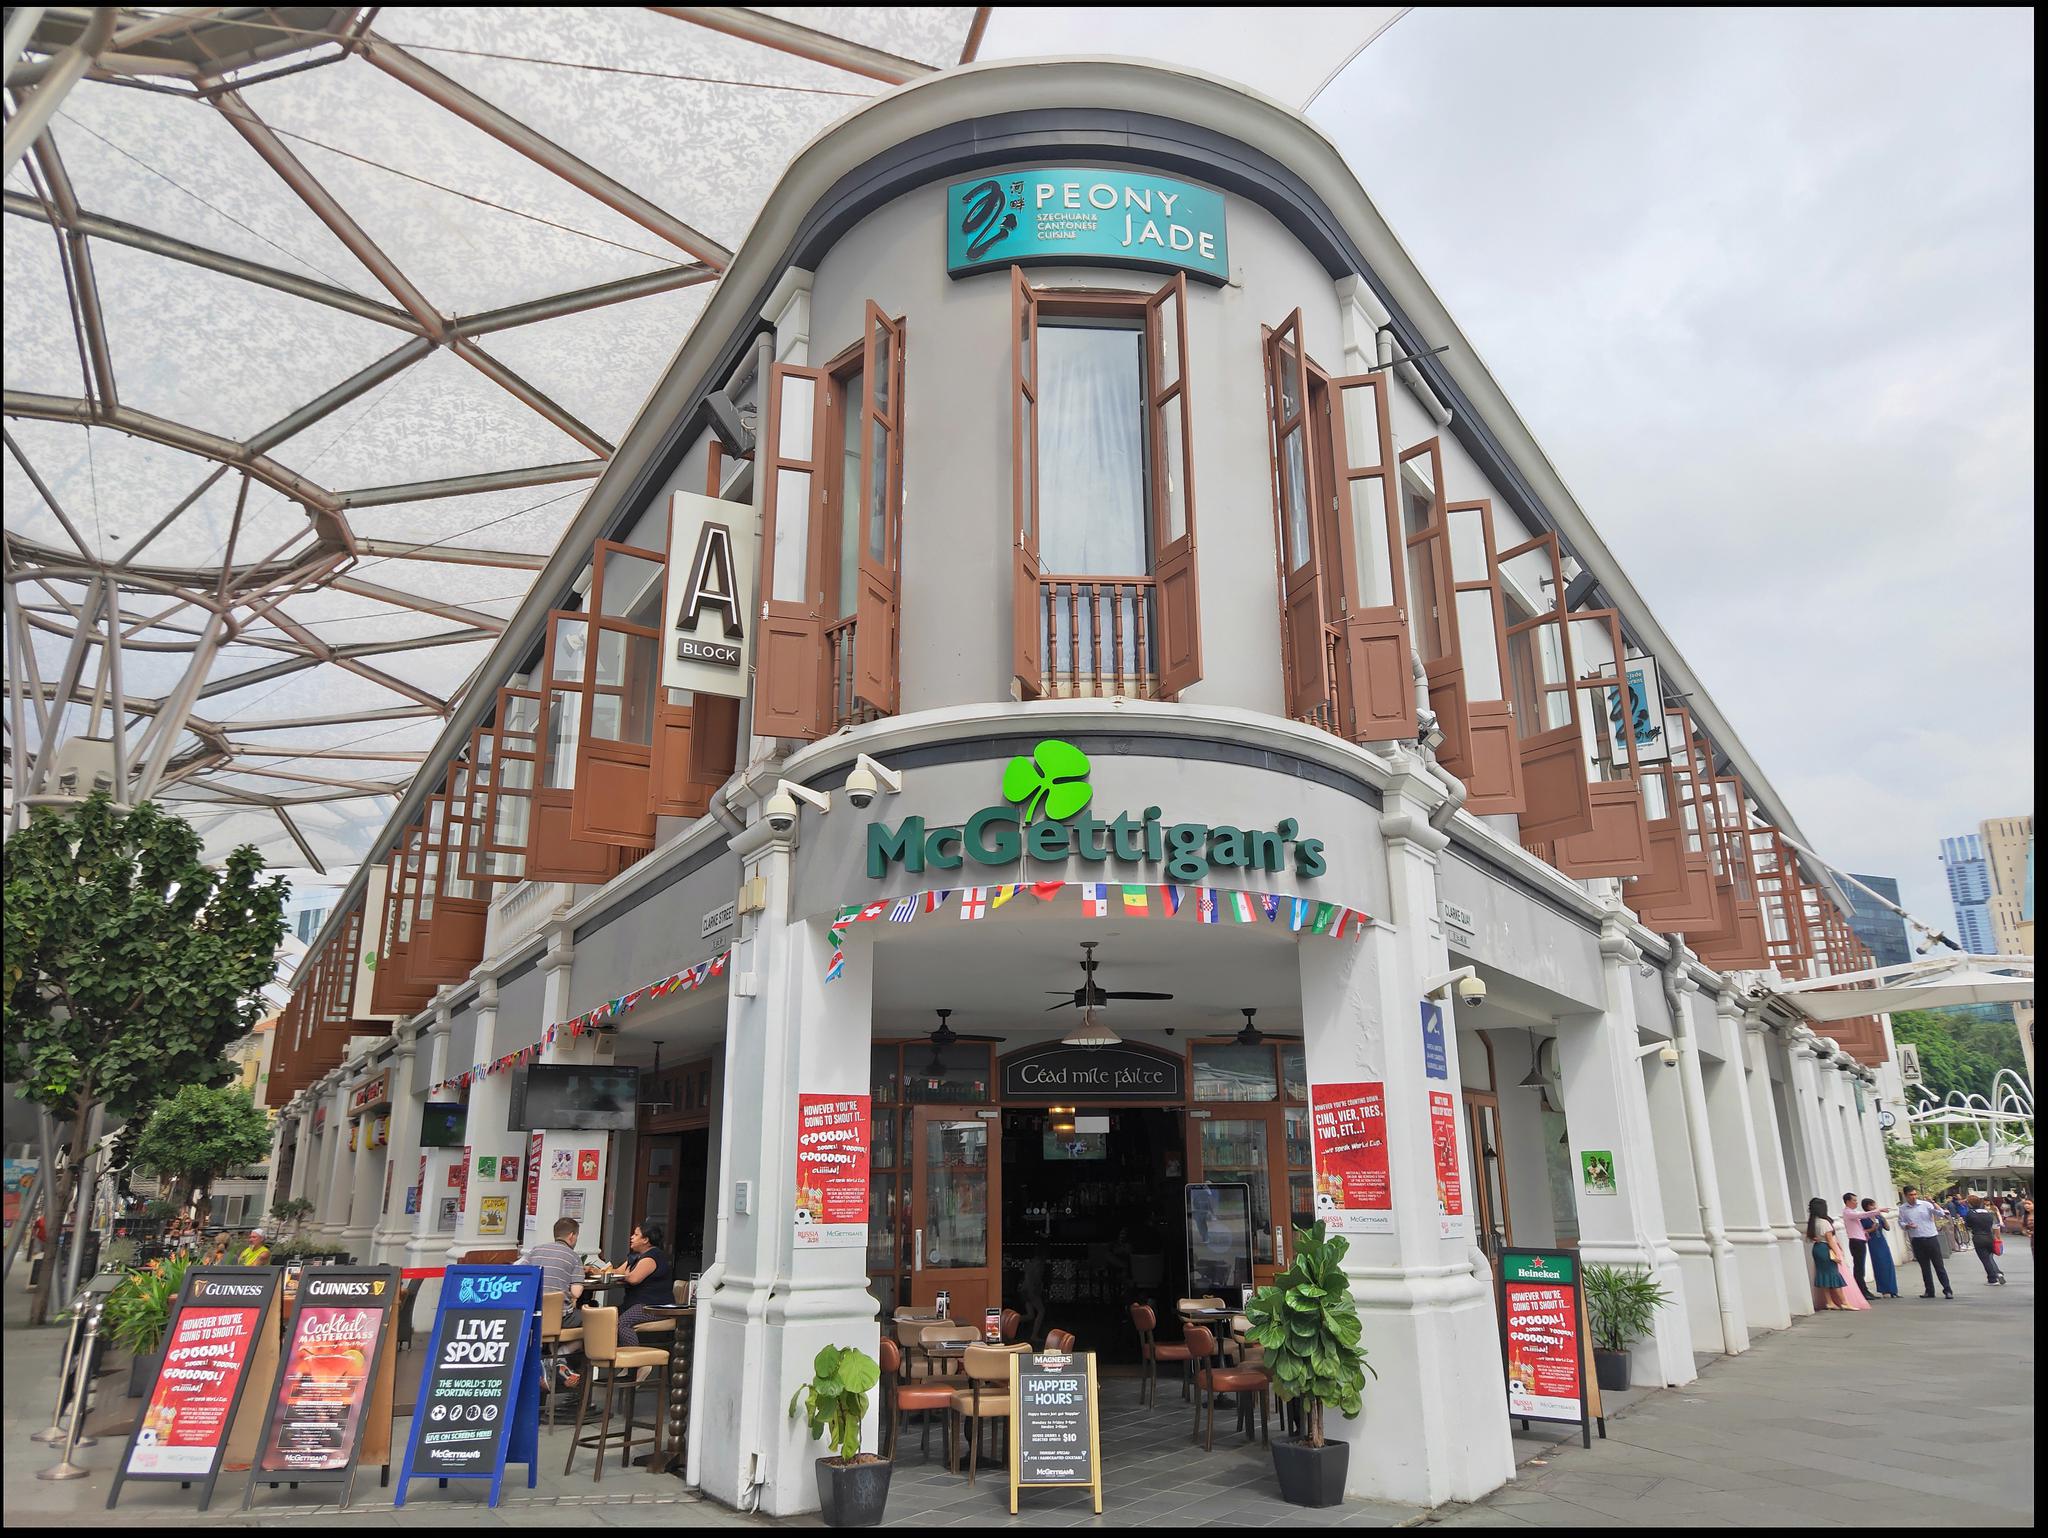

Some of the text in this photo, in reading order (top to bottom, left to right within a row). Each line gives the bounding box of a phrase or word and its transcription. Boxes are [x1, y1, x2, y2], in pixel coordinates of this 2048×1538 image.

[1036, 183, 1179, 218] PEONY
[1037, 213, 1090, 222] SZECHUAN
[1037, 221, 1098, 231] CANTONESE
[1037, 231, 1078, 240] CUISINE
[1121, 213, 1217, 260] JADE
[676, 520, 744, 639] A
[683, 642, 736, 662] BLOCK
[867, 805, 1328, 882] McGettigan's
[703, 905, 735, 932] CLARKE STREET
[1444, 904, 1472, 927] CLARKE QUAY
[1904, 1049, 1919, 1074] A
[1021, 1064, 1067, 1084] Céad
[804, 1100, 858, 1116] HOWEVER YOU'RE
[1333, 1100, 1347, 1109] YOU'RE
[804, 1111, 866, 1128] GOING TO SHOUT IT...
[1315, 1104, 1384, 1126] CINQ, VIER, TRES,
[1317, 1125, 1340, 1140] TWO,
[1518, 1268, 1561, 1279] Heineken
[206, 1283, 264, 1297] GUINNESS
[310, 1280, 372, 1295] GUINNESS
[476, 1275, 522, 1300] Tiger
[1511, 1289, 1562, 1302] HOWEVER YOU'RE
[1512, 1301, 1530, 1312] GOING
[1530, 1301, 1539, 1311] TO
[1539, 1300, 1558, 1310] SHOUT
[182, 1312, 244, 1331] HOWEVER YOU'RE
[303, 1311, 368, 1335] Cocktail
[179, 1329, 201, 1343] GOING
[202, 1328, 211, 1341] TO
[211, 1326, 234, 1340] SHOUT
[298, 1331, 375, 1343] MASTERCLASS
[456, 1319, 507, 1340] LIVE
[444, 1341, 510, 1363] SPORT
[1034, 1355, 1072, 1364] MAGNERS
[439, 1379, 503, 1388] THE WORLD'S TOP
[1028, 1379, 1078, 1392] HAPPIER
[435, 1388, 502, 1398] SPORTING EVENTS
[1035, 1393, 1073, 1405] HOURS
[426, 1432, 440, 1442] LIVE
[441, 1432, 450, 1441] ON
[1063, 1433, 1077, 1443] $10
